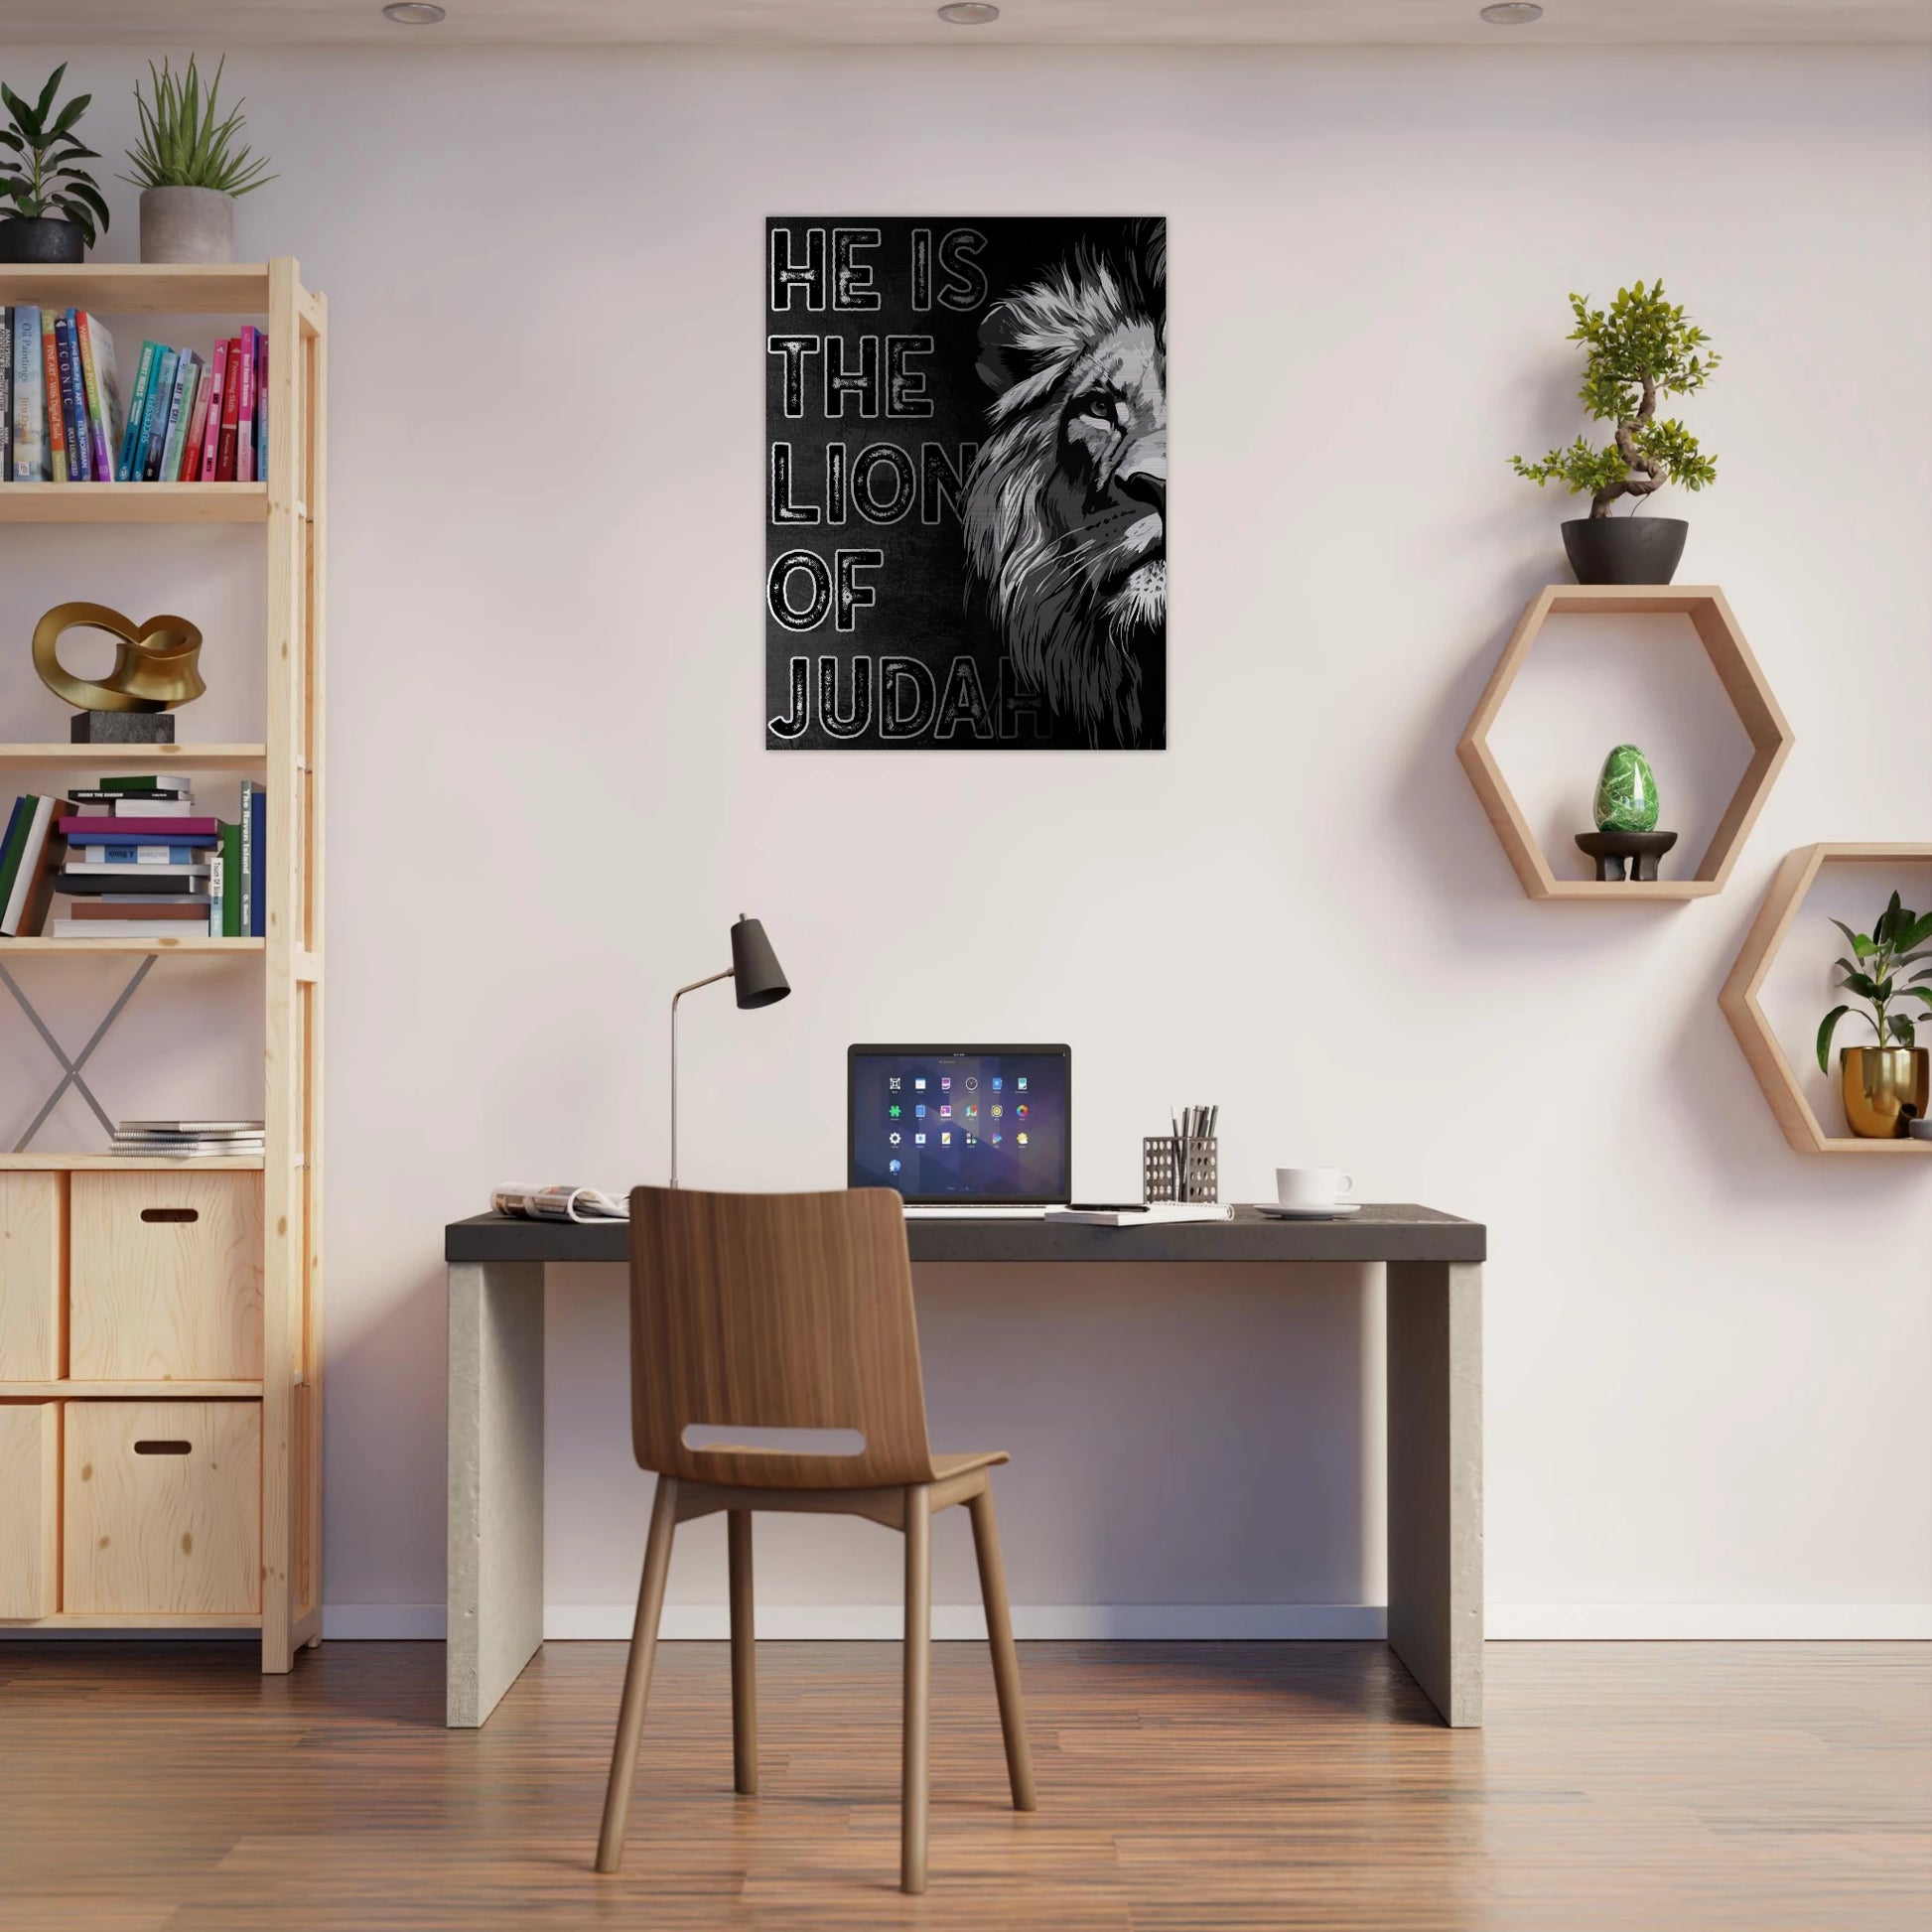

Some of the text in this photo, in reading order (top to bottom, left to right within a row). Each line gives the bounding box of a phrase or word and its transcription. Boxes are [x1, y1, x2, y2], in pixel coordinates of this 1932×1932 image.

[771, 228, 989, 312] HE IS
[19, 323, 33, 383] Oil Paintings
[48, 362, 57, 376] ART
[59, 343, 72, 405] ICONIC
[71, 356, 80, 382] Beauty
[79, 325, 97, 408] Watercolor Portraits
[229, 360, 239, 393] Parenting
[767, 335, 934, 418] THE
[48, 399, 60, 422] Digital
[49, 381, 59, 399] With
[52, 423, 62, 439] Tools
[141, 394, 157, 444] SUCCESSFUL
[78, 437, 88, 469] NORMAN
[771, 442, 979, 525] LION
[767, 548, 884, 632] OF
[767, 655, 1052, 739] JUDAH
